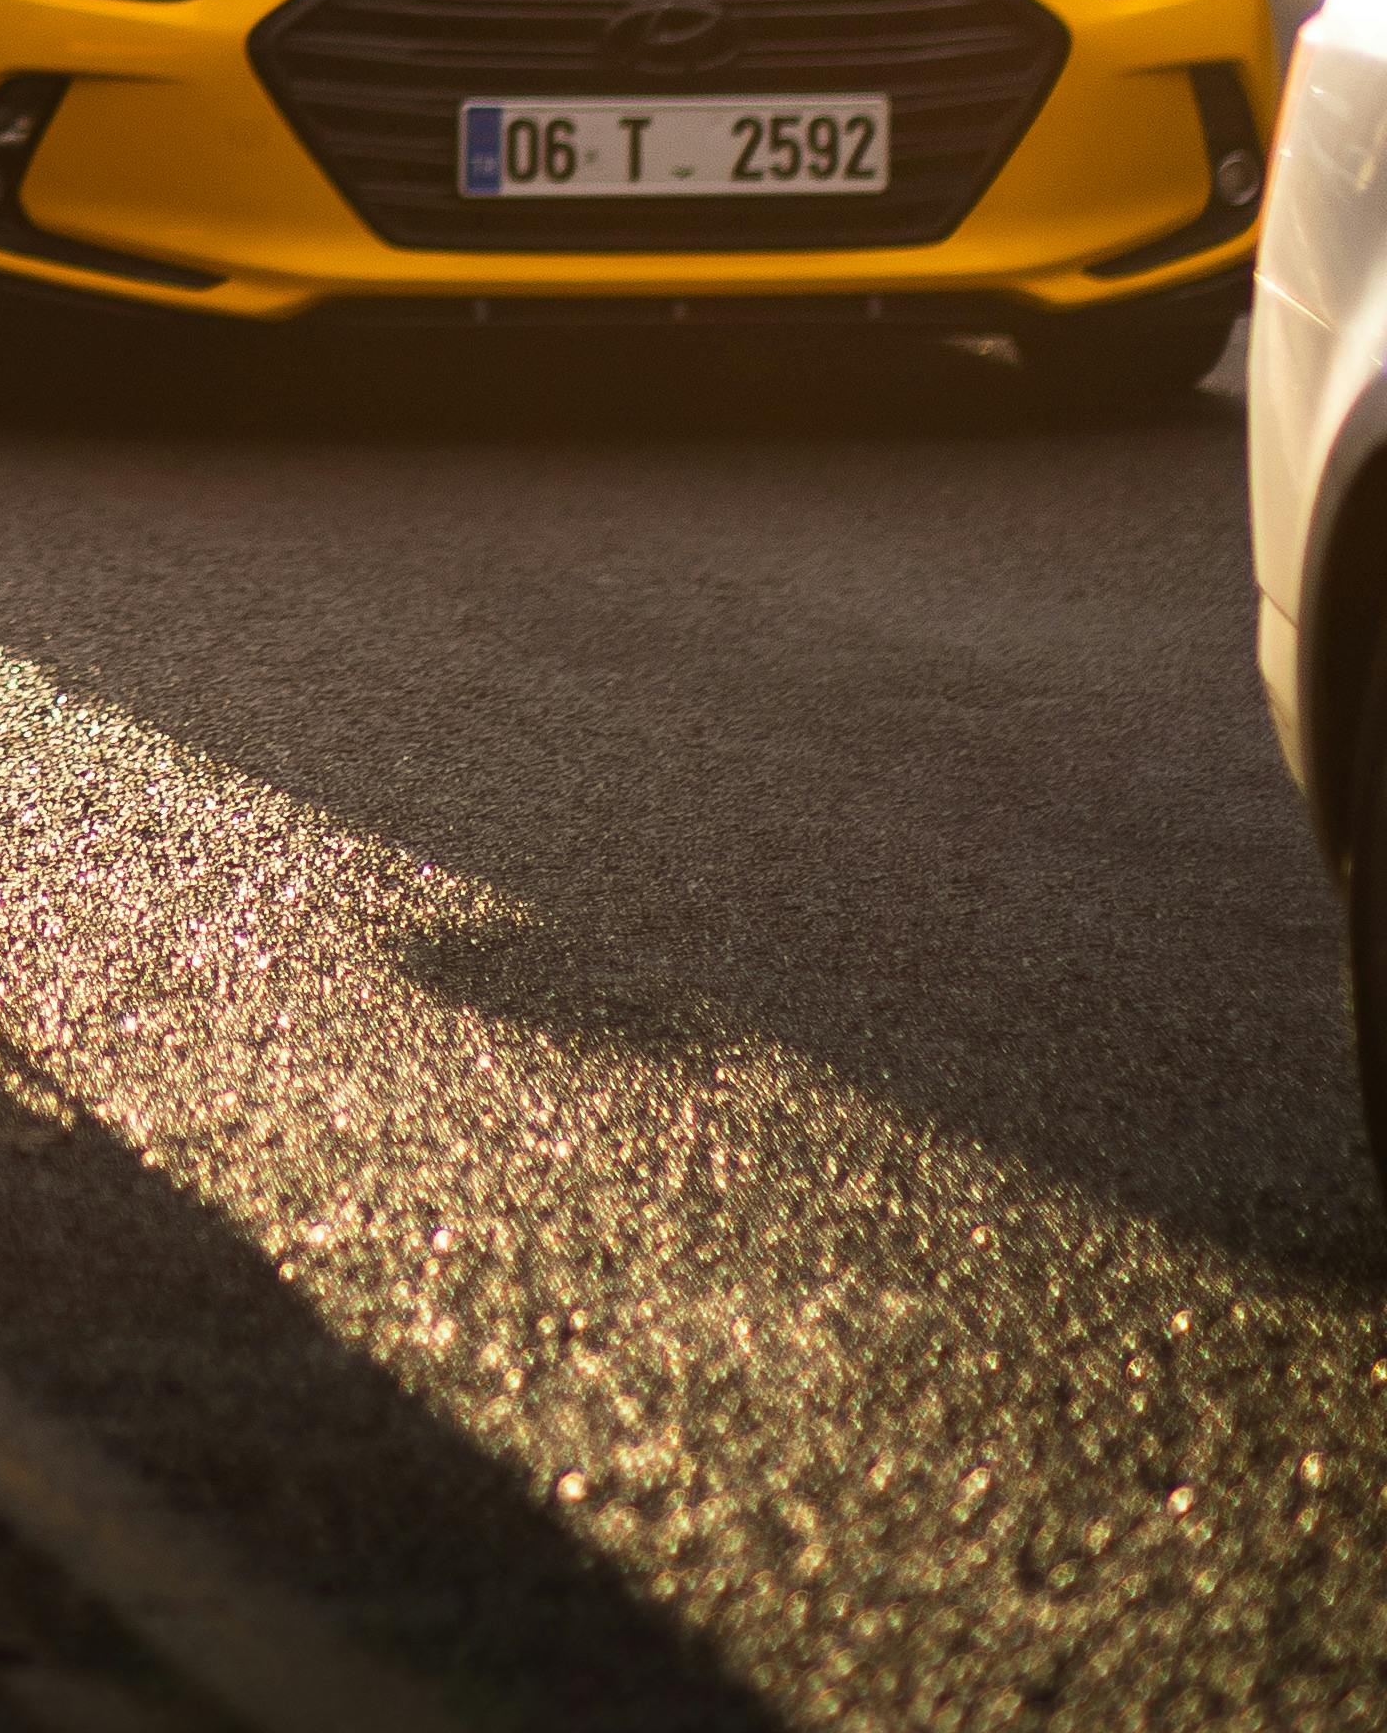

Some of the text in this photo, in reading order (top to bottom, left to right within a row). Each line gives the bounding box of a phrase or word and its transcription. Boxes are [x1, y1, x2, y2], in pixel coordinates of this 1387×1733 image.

[506, 114, 877, 184] 06 T 2592
